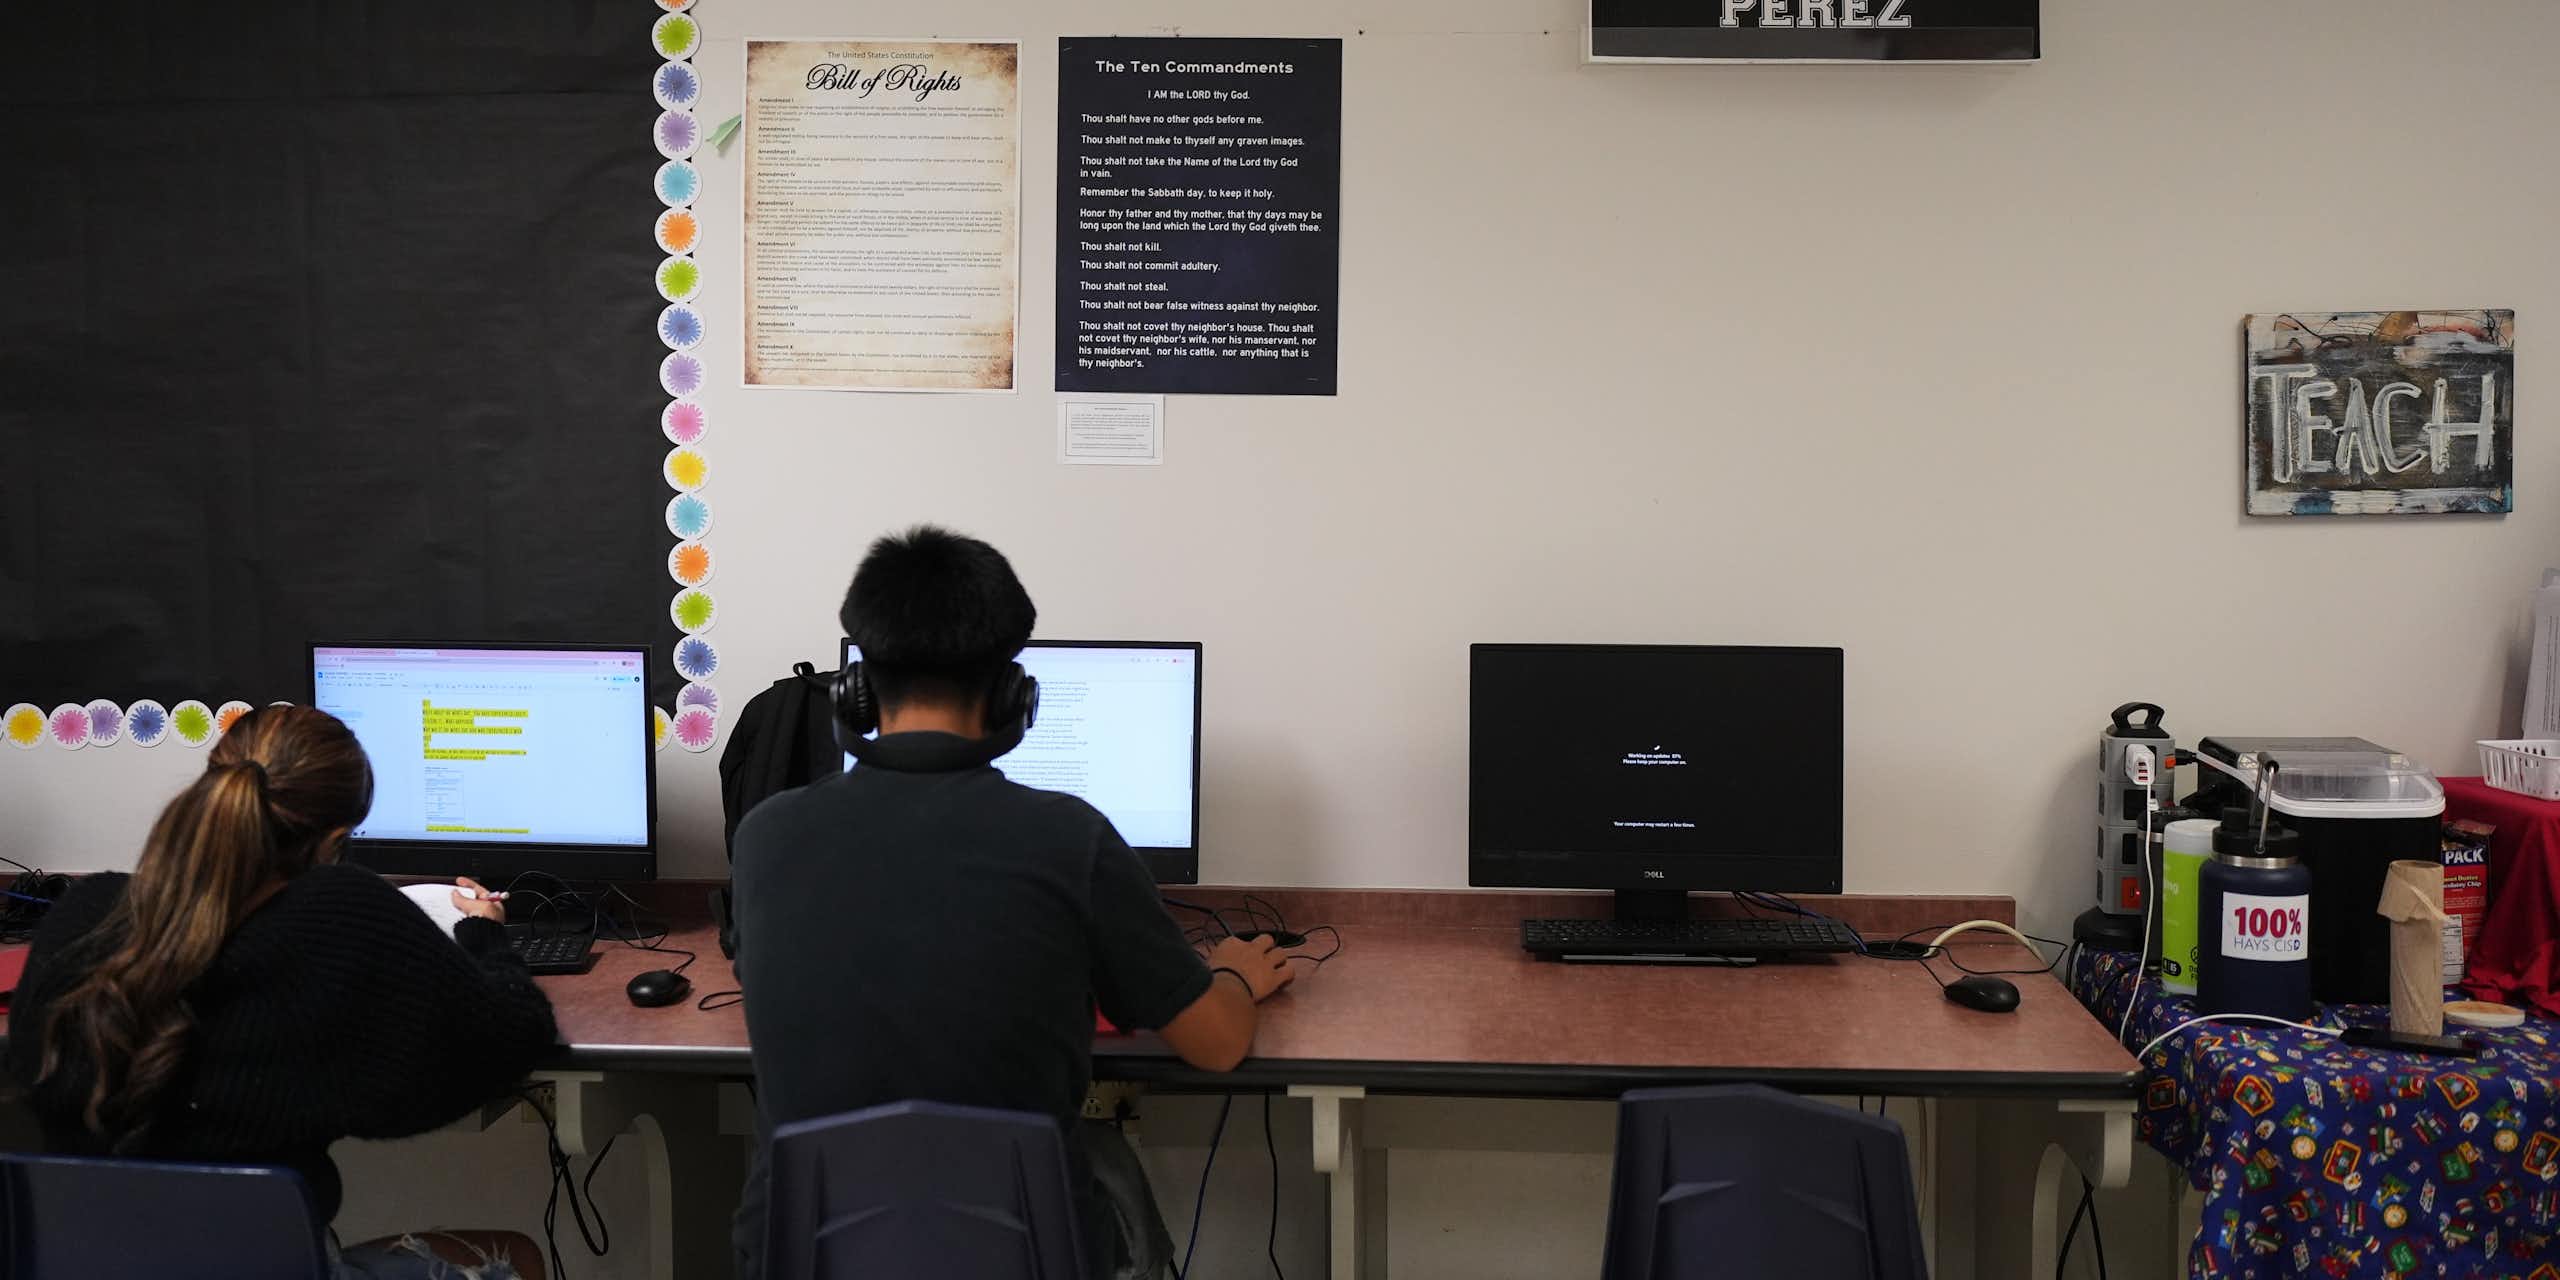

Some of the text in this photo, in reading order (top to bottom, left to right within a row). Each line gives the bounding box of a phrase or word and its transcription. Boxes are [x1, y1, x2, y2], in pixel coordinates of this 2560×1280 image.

[828, 51, 934, 60] The United States Constitution
[1095, 60, 1293, 74] The Ten Commandments
[805, 63, 963, 102] Bill of Rights
[1147, 89, 1250, 102] I AM the LORD thy God.
[1081, 113, 1263, 126] Thou shalt have no other gods before me.
[1081, 134, 1304, 148] Thou shalt not make to thyself any graven images.
[1080, 156, 1298, 169] Thou shalt not take the Name of the Lord thy God
[1080, 168, 1112, 178] in vain.
[1080, 187, 1128, 197] Remember
[1131, 188, 1145, 197] the
[1148, 187, 1184, 198] Sabbath
[1208, 188, 1217, 198] to
[1219, 188, 1241, 200] keep
[1244, 188, 1250, 198] it
[1252, 188, 1274, 201] holy.
[1080, 208, 1106, 218] Honor
[1108, 208, 1123, 221] thy
[1125, 208, 1152, 218] father
[1154, 209, 1171, 219] and
[1173, 209, 1188, 221] thy
[1226, 209, 1244, 220] that
[1246, 209, 1262, 222] thy
[1264, 210, 1286, 222] days
[1288, 212, 1308, 222] may
[1310, 210, 1322, 220] be
[1080, 220, 1320, 234] long upon the land which the Lord thy God giveth thee.
[1080, 241, 1161, 252] Thou shalt not kill.
[1080, 260, 1220, 273] Thou shalt not commit adultery.
[1080, 281, 1168, 292] Thou shalt not steal.
[1079, 299, 1319, 314] Thou shalt not bear false witness against thy neighbor.
[1079, 320, 1314, 334] Thou shalt not covet thy neighbor's house. Thou shalt
[1078, 333, 1093, 343] not
[1095, 334, 1120, 343] covet
[1122, 333, 1137, 346] thy
[1139, 333, 1186, 346] neighbor's
[1211, 336, 1226, 345] nor
[1228, 335, 1242, 345] his
[1301, 337, 1316, 346] nor
[1078, 345, 1092, 355] his
[1156, 348, 1172, 356] nor
[1173, 346, 1187, 356] his
[1222, 349, 1237, 357] nor
[1239, 347, 1278, 360] anything
[1280, 348, 1298, 358] that
[1301, 348, 1309, 358] is
[1078, 358, 1144, 370] thy neighbor's.
[2252, 363, 2496, 483] TEACH
[2445, 848, 2484, 864] PACK
[1644, 871, 1665, 879] DELL
[2234, 907, 2302, 938] 100%
[2234, 936, 2301, 952] HAYS CISD
